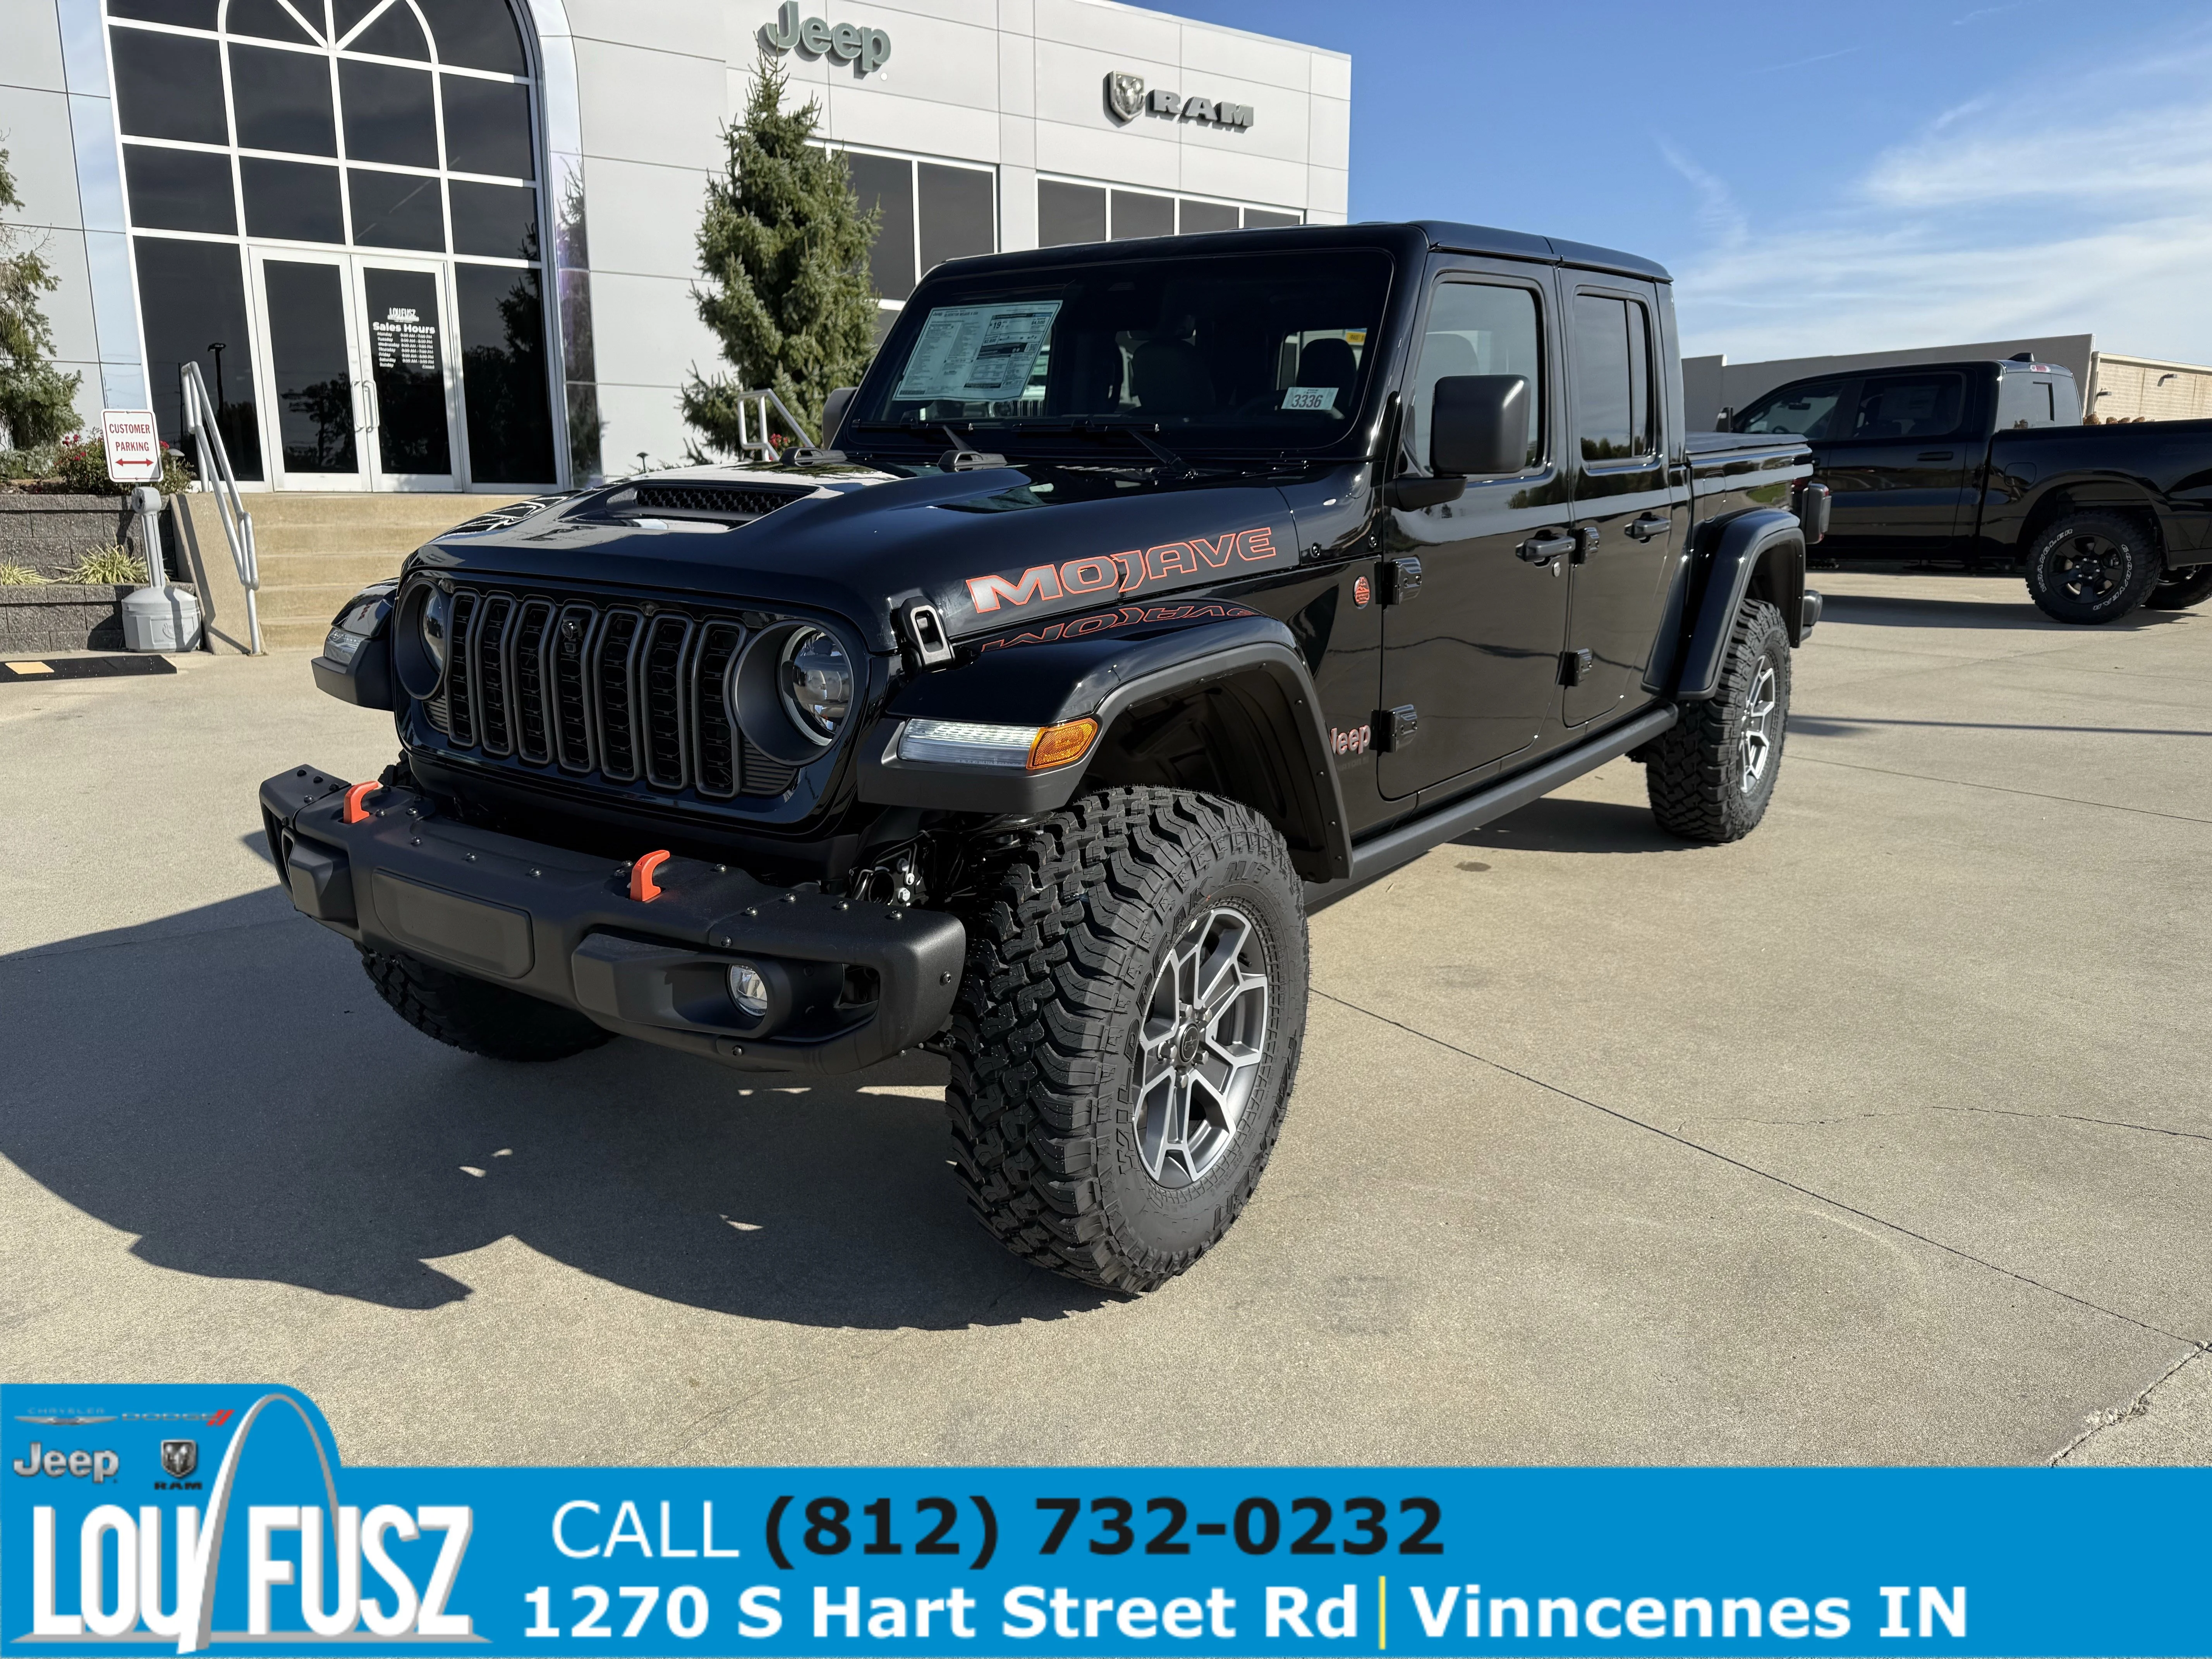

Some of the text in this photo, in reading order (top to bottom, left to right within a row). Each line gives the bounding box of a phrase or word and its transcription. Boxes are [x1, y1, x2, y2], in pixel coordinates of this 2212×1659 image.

[758, 0, 891, 73] Jeep
[1148, 89, 1254, 129] RAM
[373, 322, 435, 334] Sales Hours
[1291, 395, 1323, 408] 3336
[109, 424, 151, 434] CUSTOMER
[115, 441, 149, 452] PARKING
[965, 527, 1276, 613] MOJAVE
[2037, 528, 2073, 592] WRANGLER
[2093, 544, 2133, 611] GOODYEAR
[1329, 725, 1371, 755] Jeep
